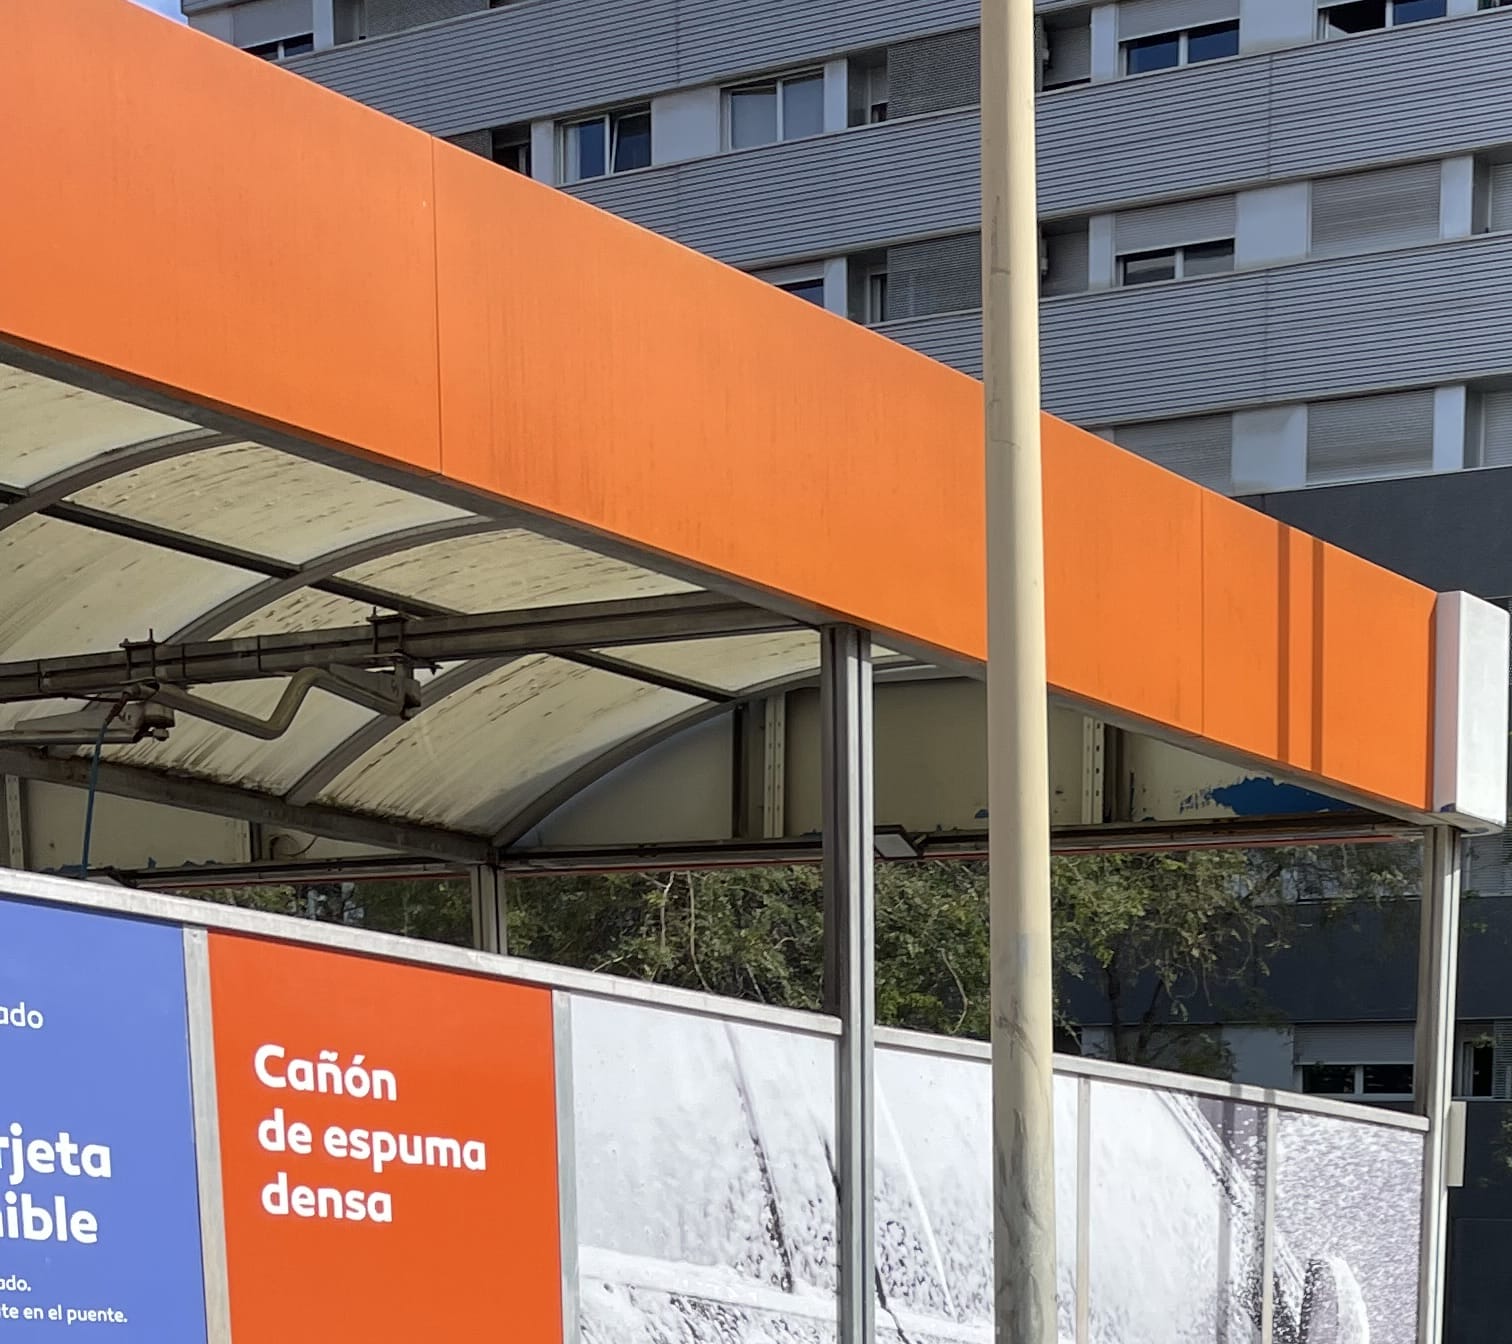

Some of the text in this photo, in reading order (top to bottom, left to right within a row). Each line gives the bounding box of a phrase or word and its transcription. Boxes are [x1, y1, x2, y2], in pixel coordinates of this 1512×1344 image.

[254, 1044, 397, 1101] Cañón
[258, 1107, 487, 1173] de espuma
[0, 1190, 98, 1244] ible
[261, 1171, 393, 1223] densa
[0, 1303, 129, 1326] te en el puente.
